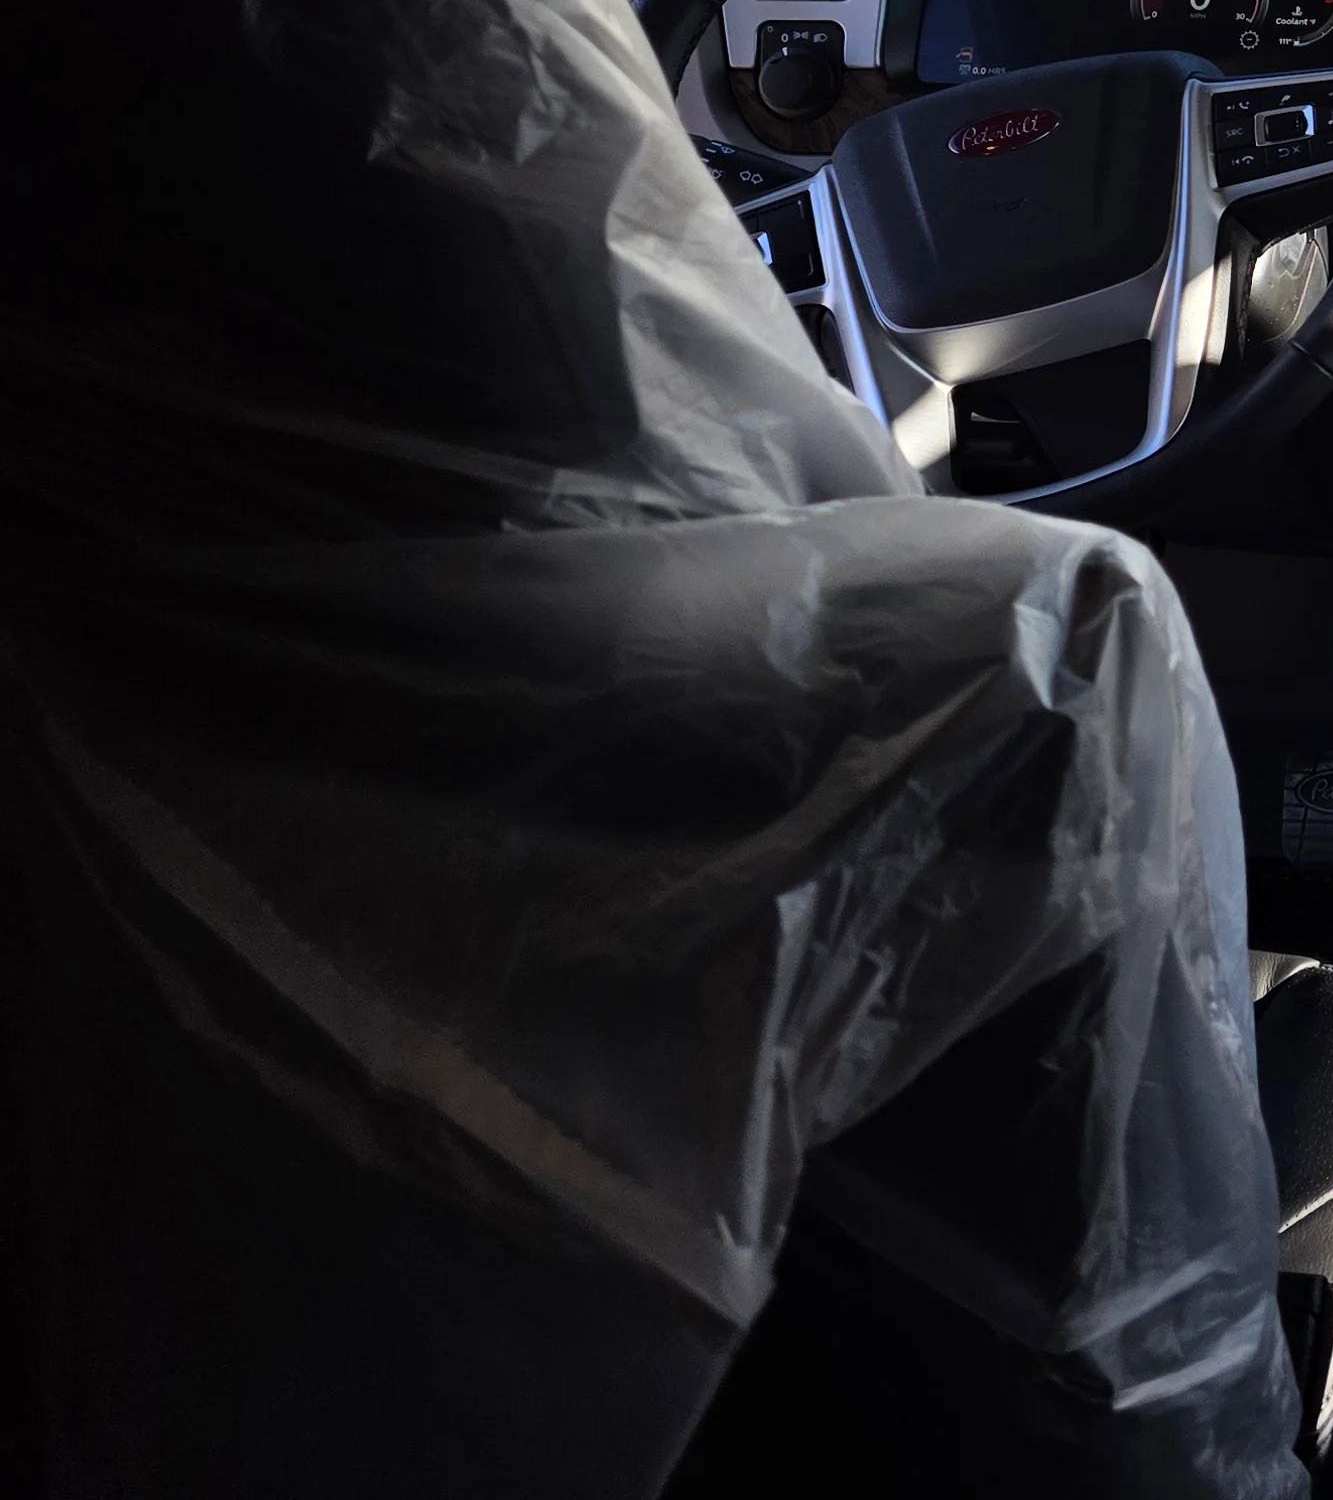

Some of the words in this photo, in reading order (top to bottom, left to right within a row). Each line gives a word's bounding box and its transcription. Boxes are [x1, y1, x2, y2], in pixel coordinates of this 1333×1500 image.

[1235, 12, 1245, 20] 30
[1275, 18, 1308, 26] Coolant
[972, 66, 987, 75] 0.0
[962, 114, 1039, 151] Peterbilt
[1225, 127, 1244, 138] SRC
